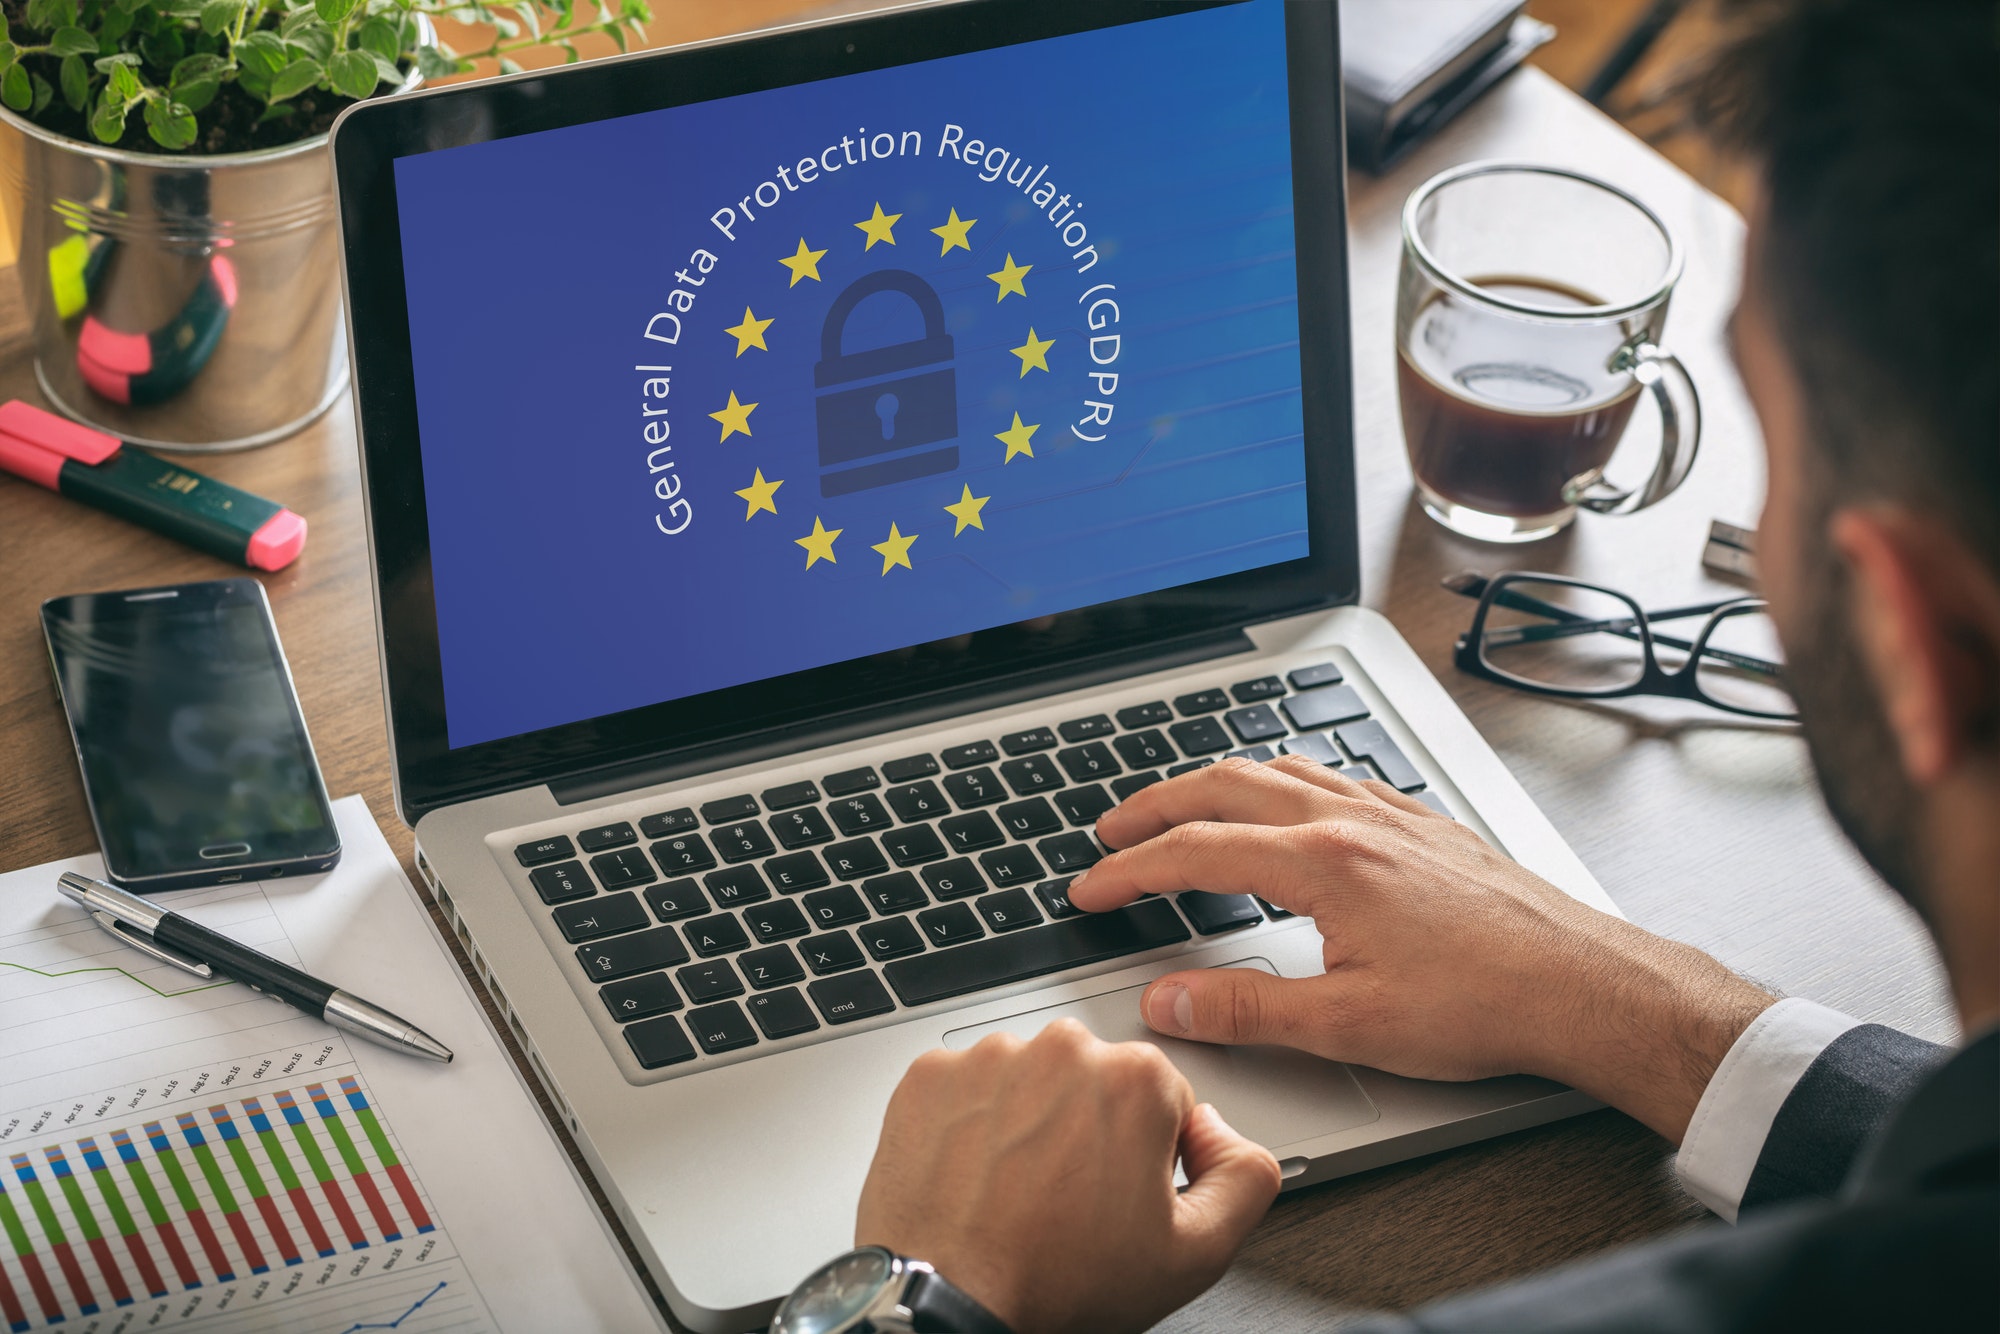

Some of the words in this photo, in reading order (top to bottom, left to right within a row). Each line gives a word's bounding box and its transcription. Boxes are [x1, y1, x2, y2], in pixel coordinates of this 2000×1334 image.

[710, 127, 922, 242] Protection
[938, 123, 1099, 274] Regulation
[644, 249, 718, 344] Data
[1071, 284, 1120, 441] (GDPR)
[635, 366, 692, 534] General
[1144, 747, 1157, 758] 0
[1088, 760, 1099, 770] 9
[966, 774, 979, 785] &
[1031, 773, 1044, 783] 8
[973, 786, 983, 797] 7
[848, 800, 865, 811] %
[918, 799, 929, 809] 6
[1071, 806, 1080, 817] I
[792, 813, 804, 824] $
[859, 812, 870, 823] 5
[1013, 818, 1029, 829] U
[734, 827, 744, 838] #
[802, 825, 812, 835] 4
[955, 831, 968, 842] Y
[537, 843, 556, 852] esc
[672, 841, 686, 850] @
[741, 840, 753, 850] 3
[897, 845, 908, 856] T
[616, 855, 624, 864] !
[681, 853, 694, 864] 2
[1058, 853, 1066, 864] J
[838, 859, 853, 870] R
[555, 870, 566, 878] ±
[622, 867, 632, 877] 1
[996, 865, 1013, 877] H
[779, 872, 793, 884] E
[562, 880, 573, 890] §
[938, 879, 953, 890] G
[720, 885, 738, 898] W
[879, 893, 889, 905] F
[1052, 895, 1069, 909] N
[661, 900, 678, 911] Q
[819, 908, 834, 919] D
[992, 911, 1007, 922] B
[760, 921, 773, 932] S
[934, 924, 947, 936] V
[703, 935, 716, 947] A
[875, 939, 890, 950] C
[815, 952, 831, 964] X
[754, 967, 770, 979] Z
[756, 996, 769, 1006] alt
[831, 1001, 855, 1013] cmd
[709, 1031, 726, 1042] ctrl
[314, 1046, 335, 1067] Dez.16
[283, 1053, 304, 1075] Nov.16
[253, 1060, 272, 1081] Okt.16
[221, 1066, 242, 1087] Sep.16
[190, 1073, 211, 1095] Aug.16
[161, 1080, 180, 1101] Jul.16
[128, 1088, 148, 1110] Jun.16
[95, 1096, 117, 1119] Mai.16
[65, 1104, 85, 1126] Apr.16
[416, 1240, 435, 1262] Dez.16
[382, 1248, 403, 1271] Nov.16
